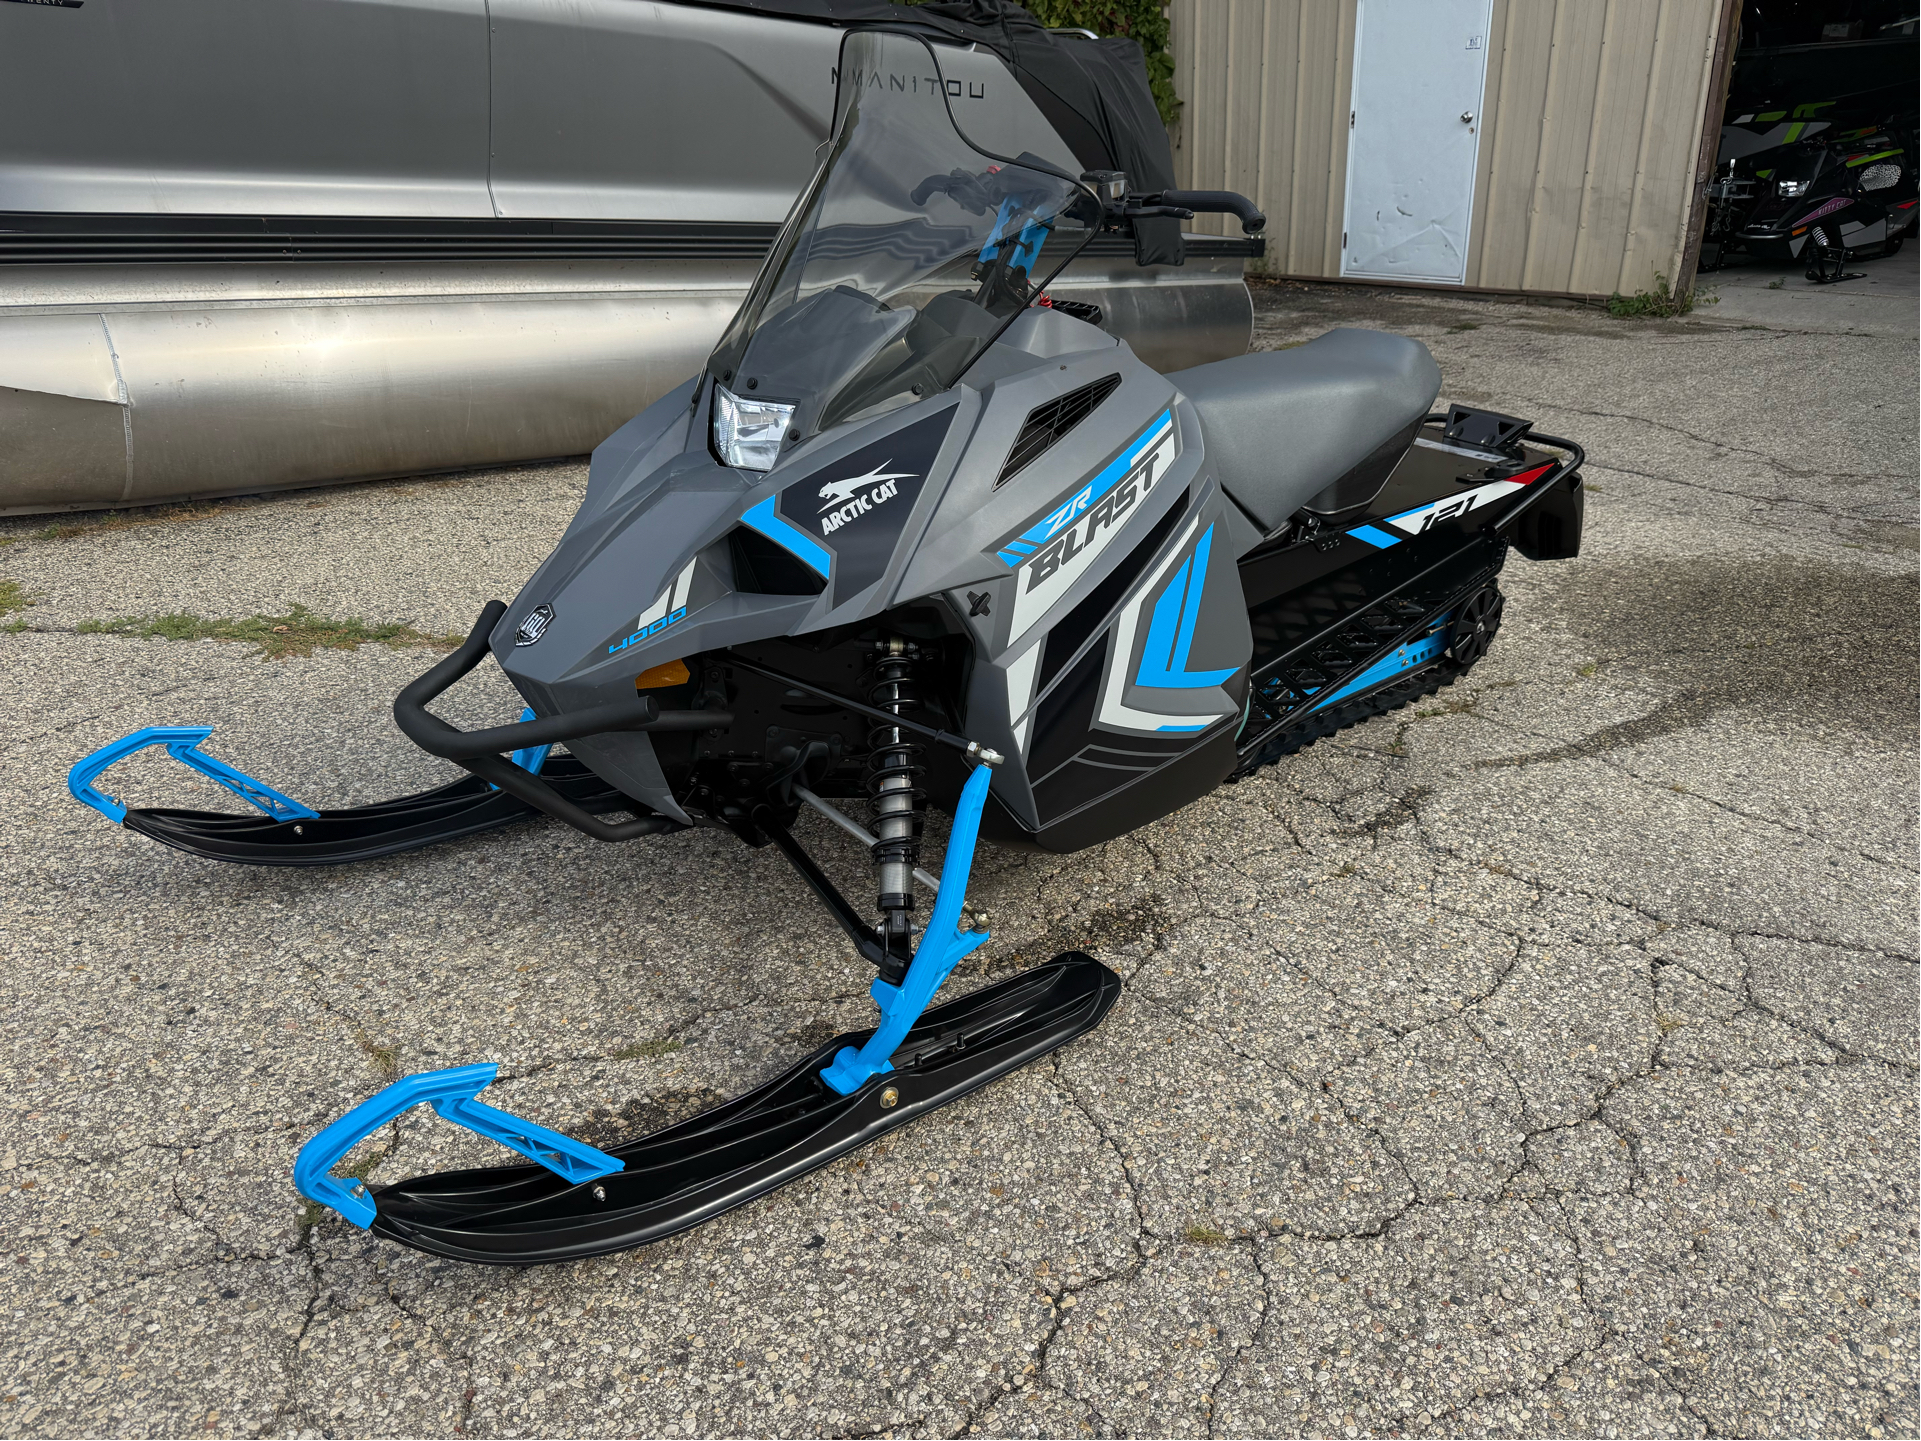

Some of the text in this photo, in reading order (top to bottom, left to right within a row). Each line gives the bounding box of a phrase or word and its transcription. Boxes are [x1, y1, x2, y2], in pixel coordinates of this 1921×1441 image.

[821, 478, 898, 536] ARCTIC CAT
[1025, 452, 1159, 595] BLAST
[1043, 485, 1092, 540] ZR
[1418, 494, 1478, 533] 121
[608, 606, 687, 654] 4000
